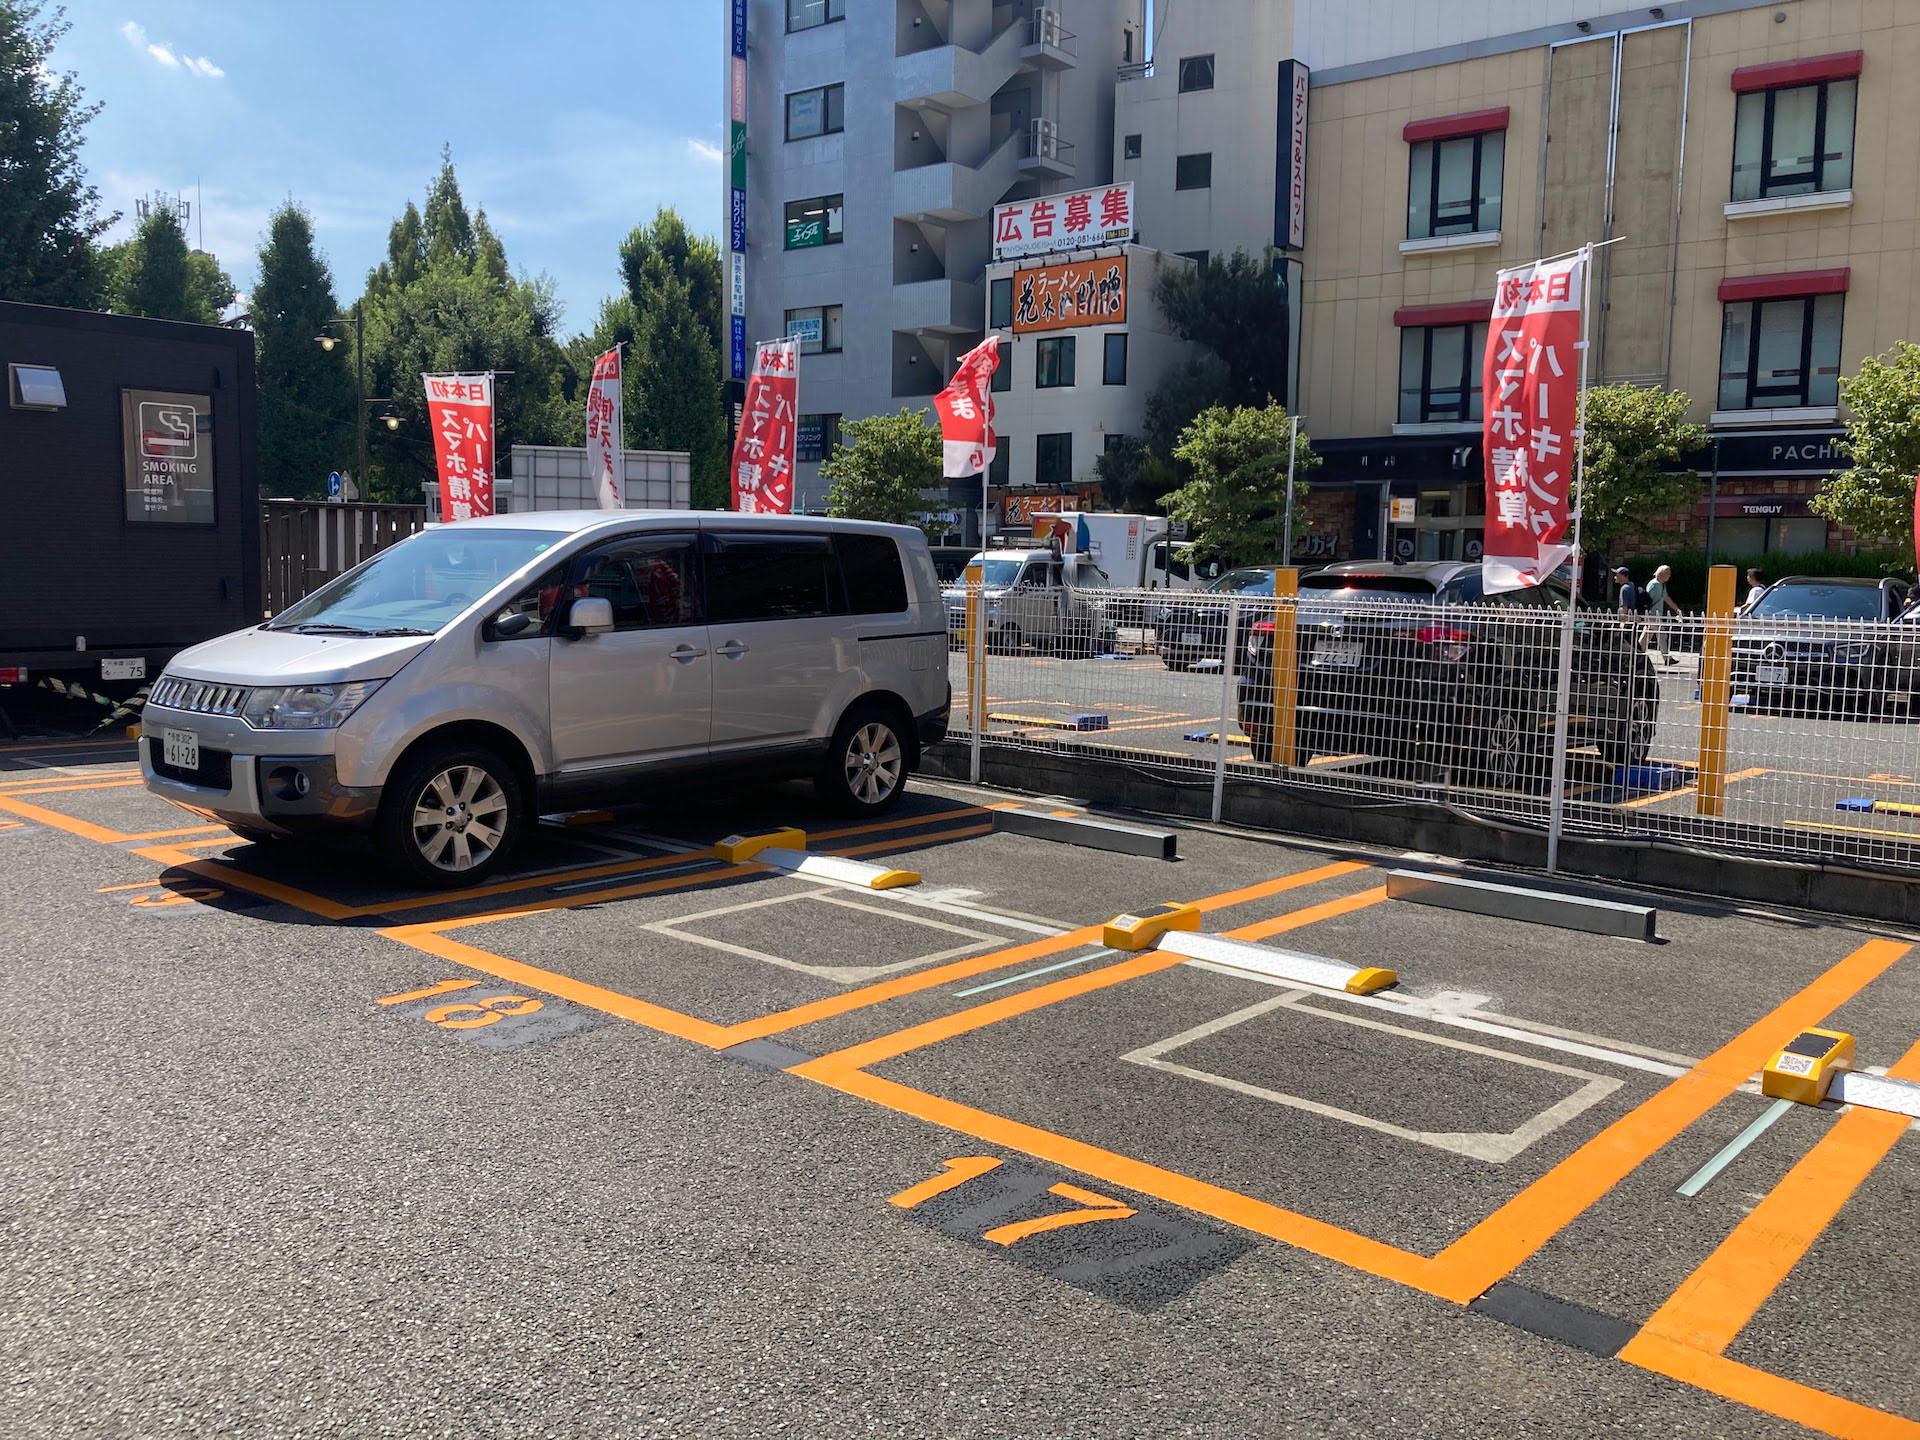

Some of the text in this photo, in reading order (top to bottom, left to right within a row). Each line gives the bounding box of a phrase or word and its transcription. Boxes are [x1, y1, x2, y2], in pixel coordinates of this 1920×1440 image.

[996, 188, 1129, 244] 広告募集
[1057, 233, 1105, 248] 0120-081-666
[1038, 270, 1080, 295] ラーメン
[142, 461, 197, 474] SMOKING
[143, 474, 174, 485] AREA
[1023, 496, 1057, 508] ラーメン
[1743, 505, 1782, 514] TENGUY
[95, 876, 225, 908] 19
[377, 978, 544, 1029] 18
[887, 1155, 1138, 1247] 17
